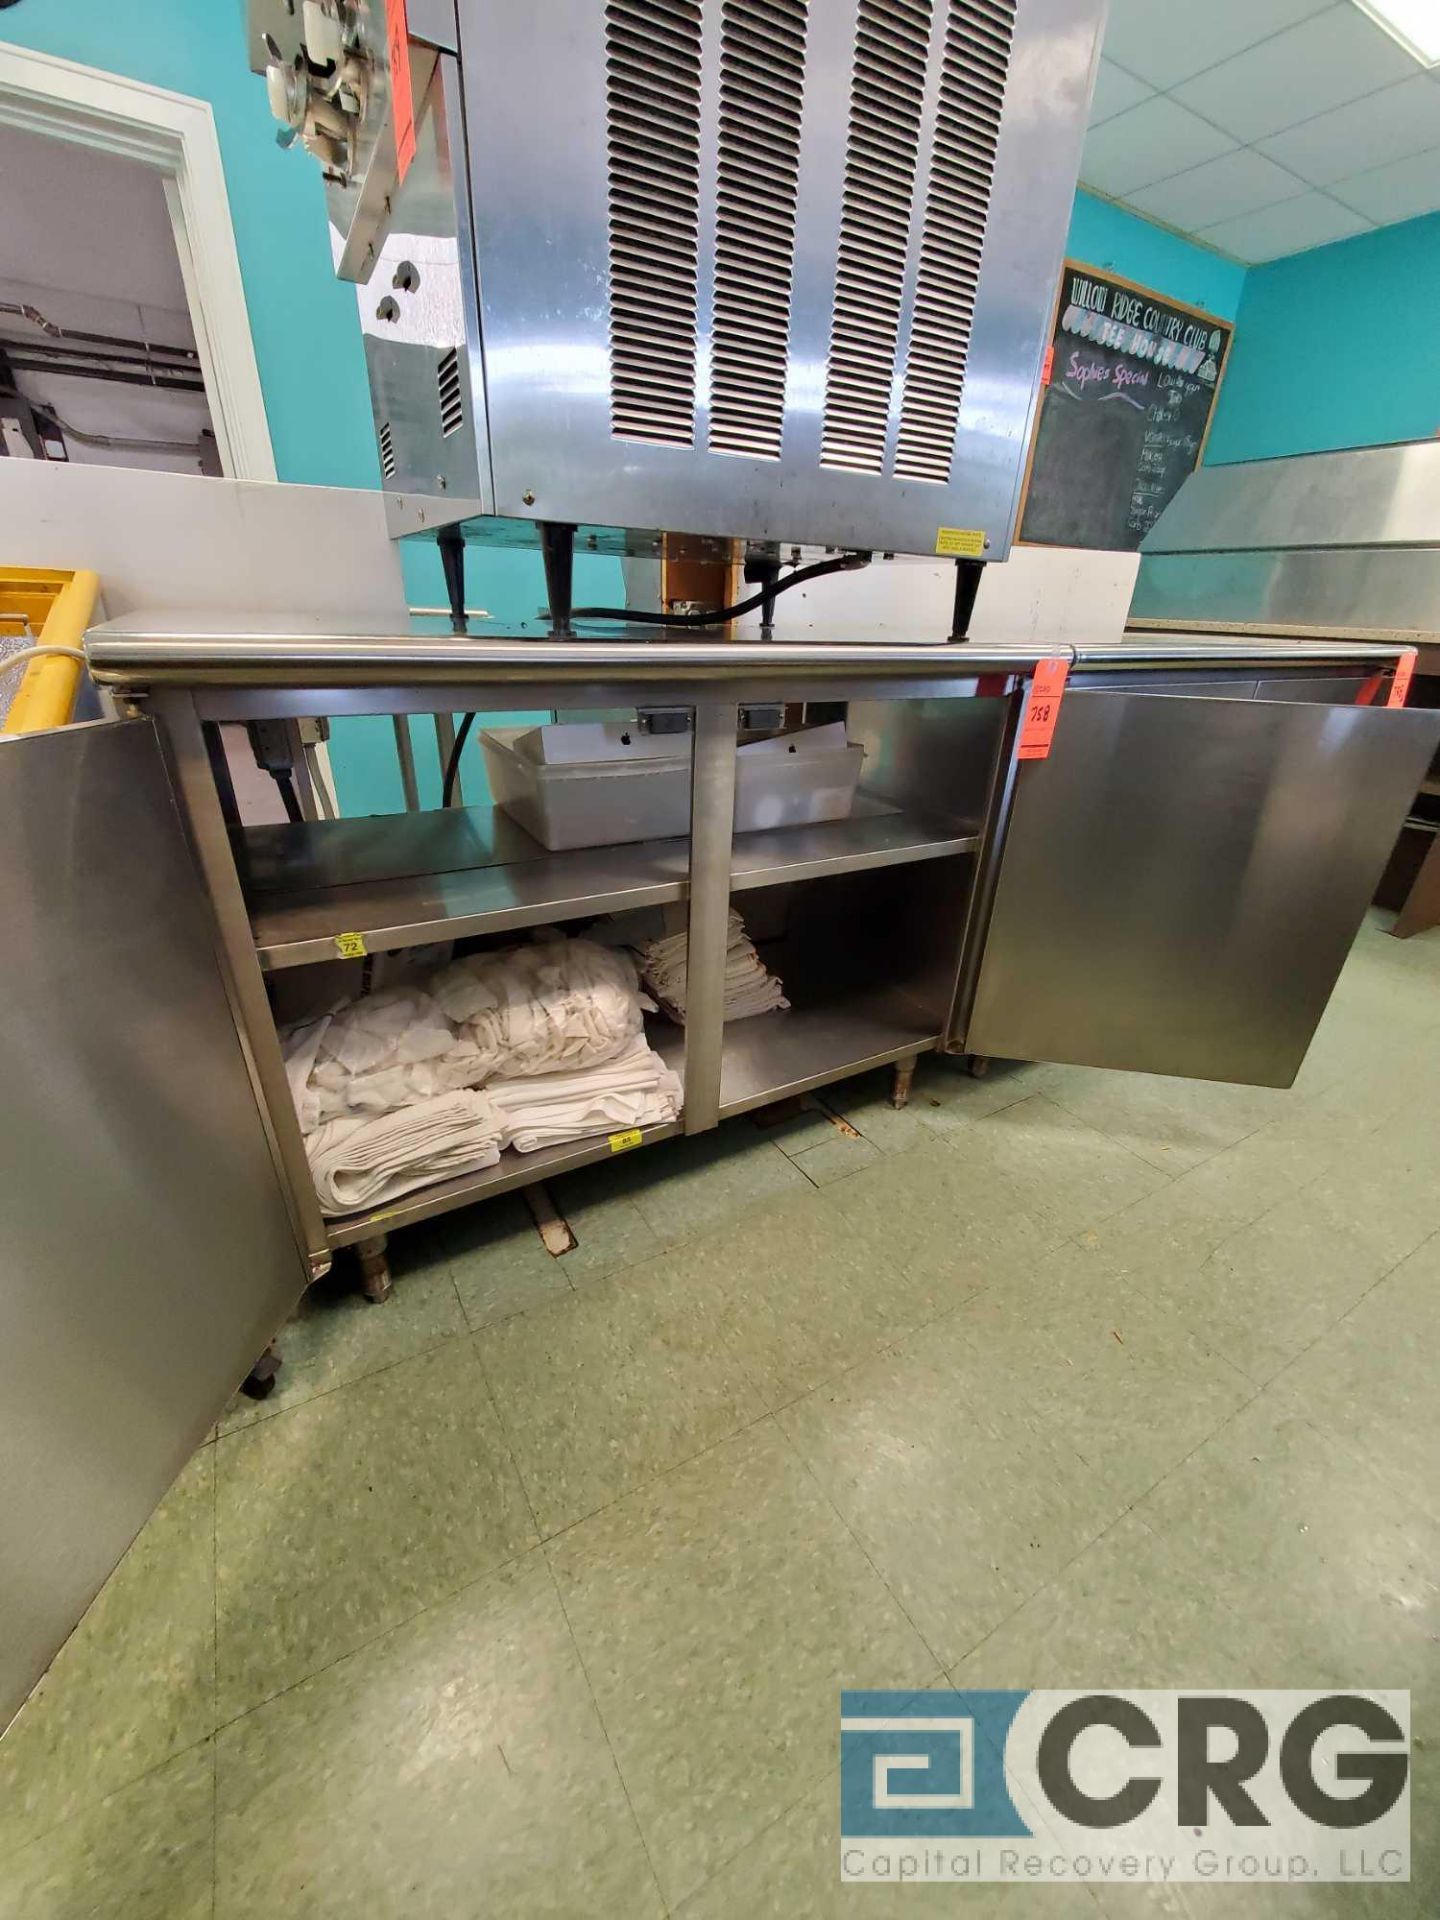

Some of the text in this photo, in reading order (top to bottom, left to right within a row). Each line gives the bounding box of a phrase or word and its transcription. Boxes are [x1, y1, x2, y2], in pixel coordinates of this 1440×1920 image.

[1071, 277, 1109, 313] WILLOW
[1111, 292, 1143, 326] RIDGE
[1184, 324, 1208, 351] CLUB
[1030, 704, 1051, 723] 758
[343, 942, 358, 952] 72
